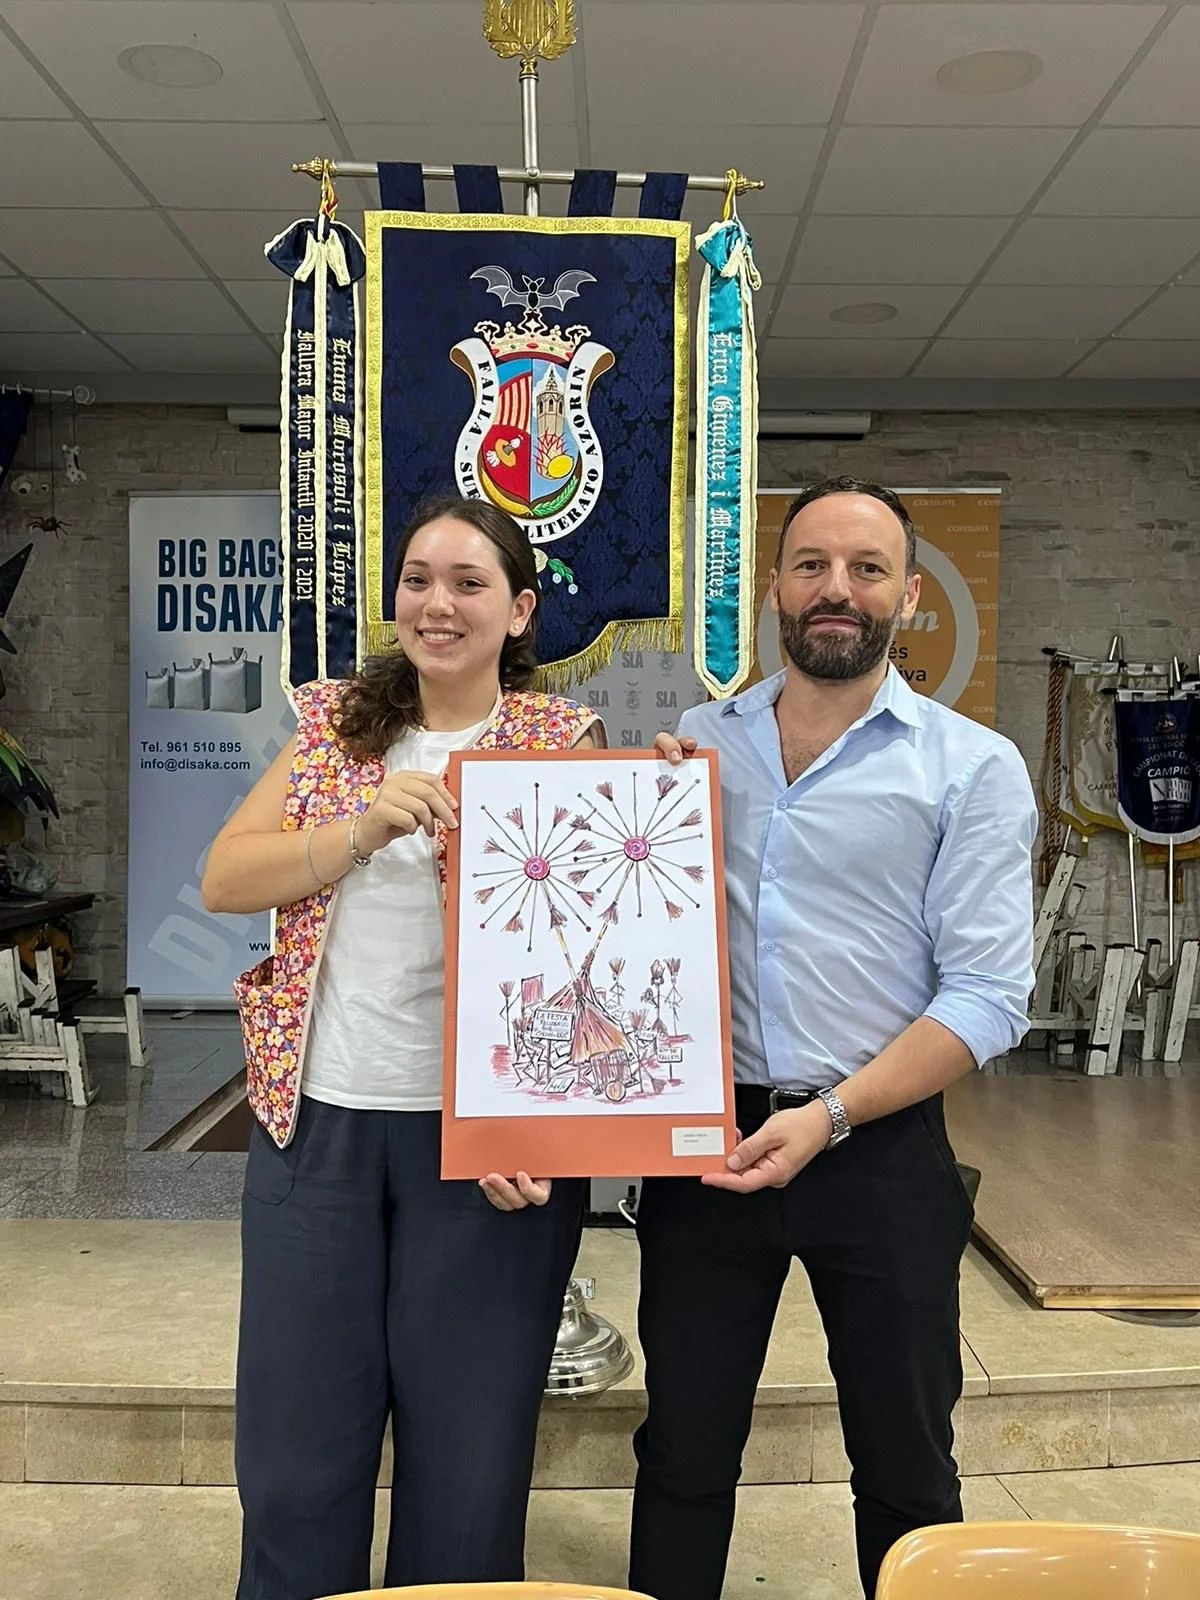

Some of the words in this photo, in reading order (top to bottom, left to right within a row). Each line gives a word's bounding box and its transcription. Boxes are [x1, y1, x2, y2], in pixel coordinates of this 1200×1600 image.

[332, 337, 352, 403] Emma
[469, 360, 494, 437] FALLA
[523, 468, 599, 539] LITERATO
[297, 447, 316, 509] Infantil
[297, 514, 314, 550] 2020
[334, 520, 350, 531] i
[158, 539, 207, 578] BIG
[296, 567, 313, 601] 2021
[332, 540, 352, 607] López
[622, 651, 644, 668] SLA
[588, 690, 610, 707] SLA
[656, 691, 677, 708] SLA
[140, 742, 163, 753] Tel.
[166, 742, 191, 753] 961
[193, 742, 215, 753] 510
[219, 742, 242, 753] 895
[621, 729, 643, 746] SLA
[140, 758, 251, 771] info@disaka.com
